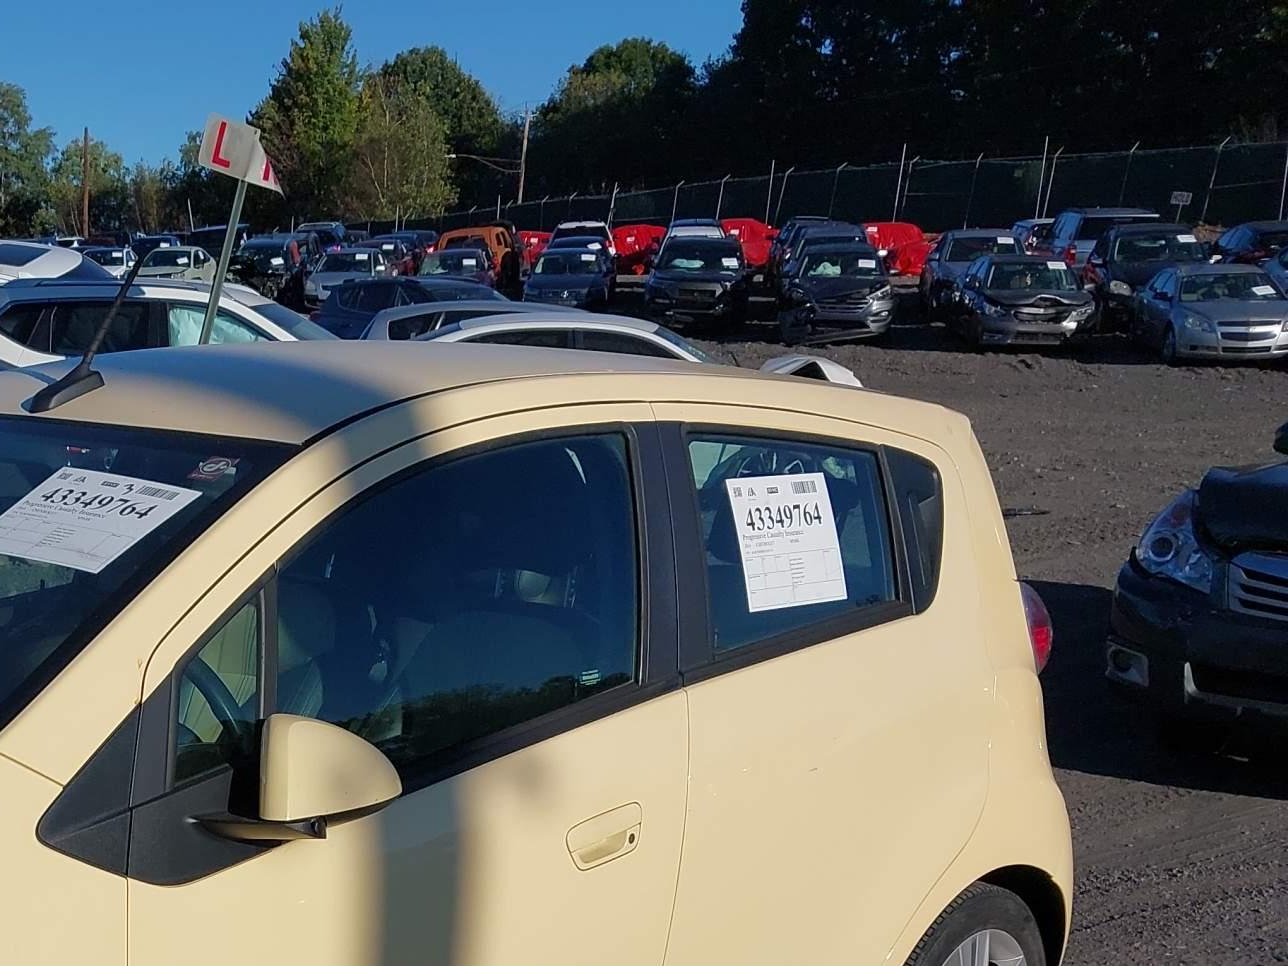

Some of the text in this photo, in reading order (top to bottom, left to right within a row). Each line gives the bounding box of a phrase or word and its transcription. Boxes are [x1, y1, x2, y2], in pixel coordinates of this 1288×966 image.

[212, 121, 230, 168] L
[41, 487, 159, 520] 43349764
[745, 502, 823, 531] 43349764
